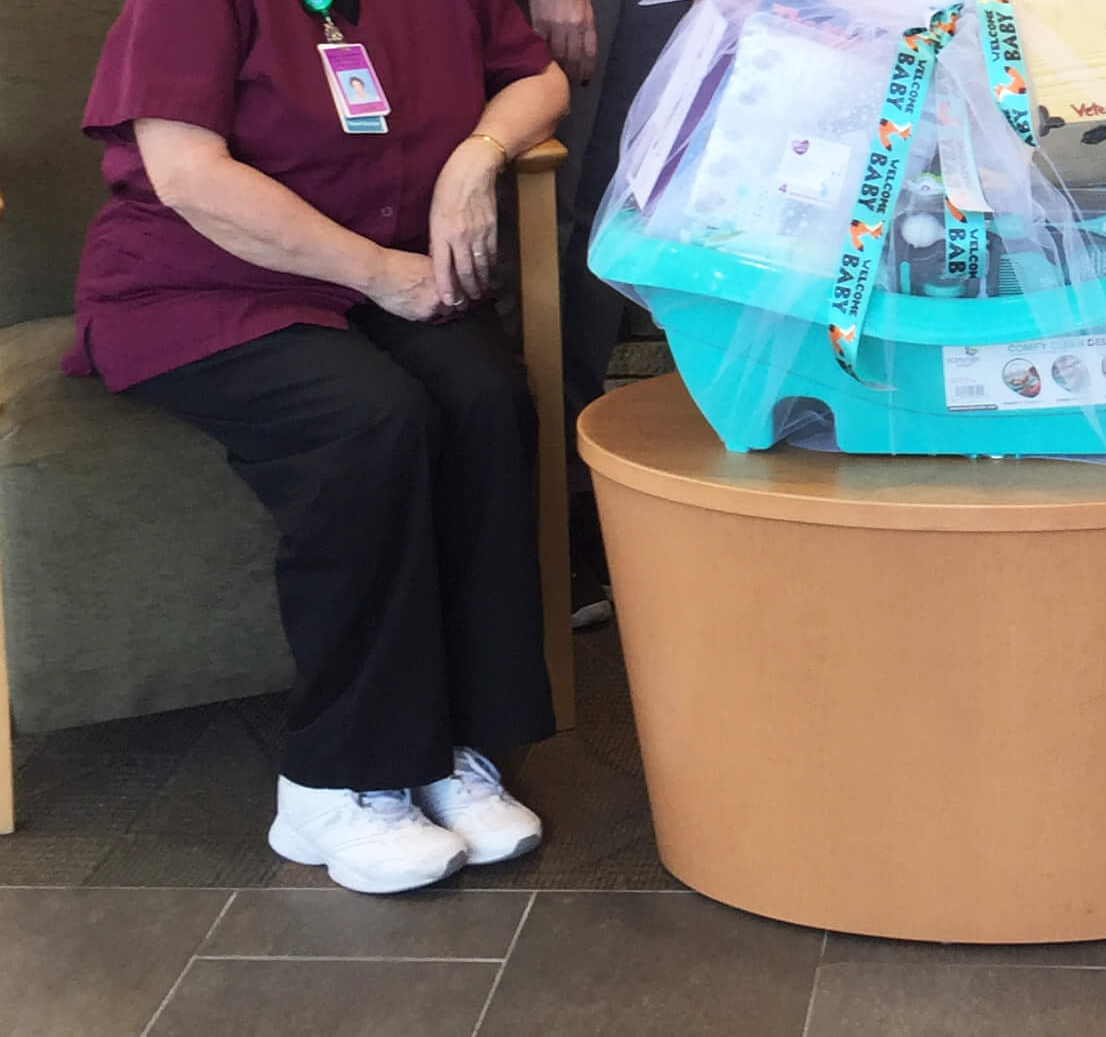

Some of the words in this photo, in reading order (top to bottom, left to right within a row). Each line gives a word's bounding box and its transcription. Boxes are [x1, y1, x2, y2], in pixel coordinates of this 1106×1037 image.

[984, 10, 1001, 62] WELCOME
[996, 11, 1022, 62] BABY
[886, 52, 916, 111] BABY
[905, 59, 928, 115] WELCOME
[857, 152, 888, 213] BABY
[876, 158, 900, 215] WELCOME
[948, 228, 967, 275] BAB
[831, 253, 860, 315] BABY
[849, 258, 872, 318] WELCOME
[1007, 342, 1046, 353] COMFY
